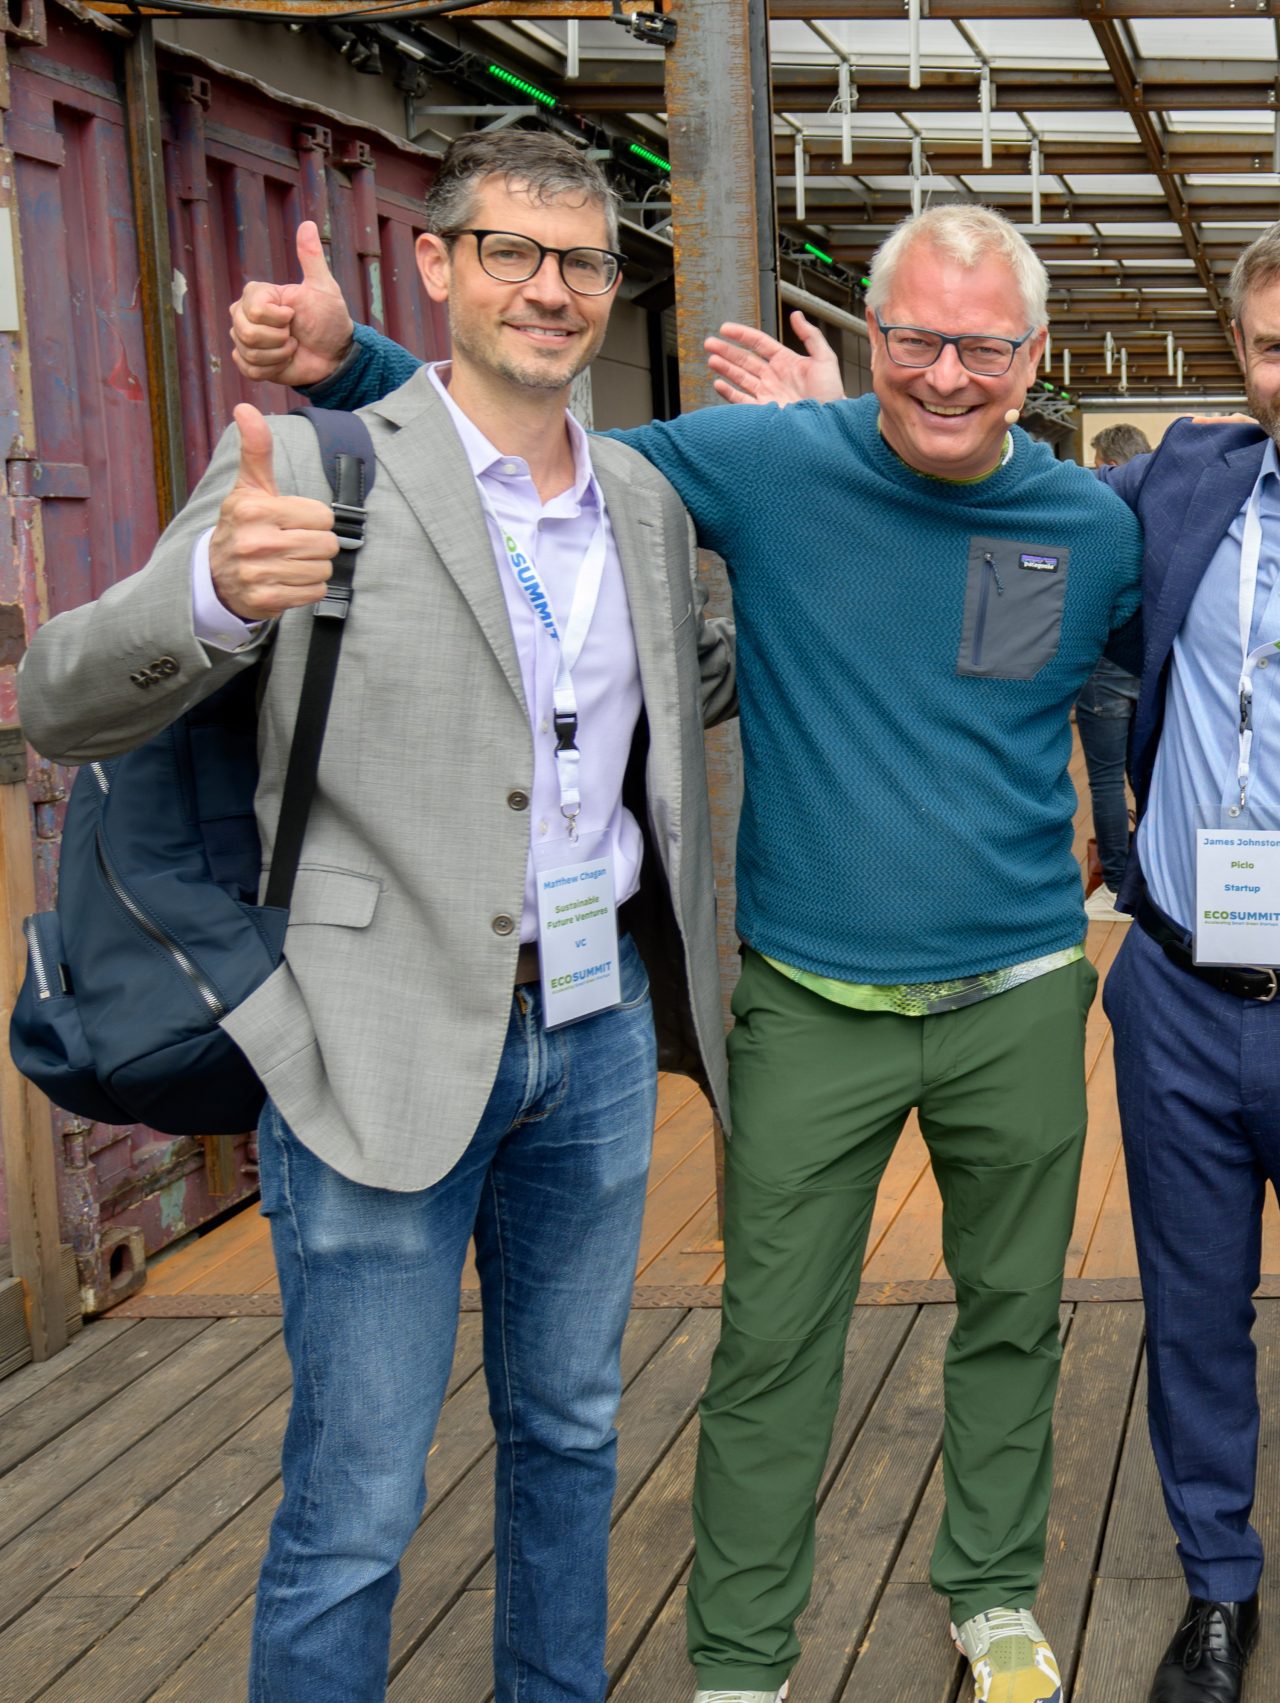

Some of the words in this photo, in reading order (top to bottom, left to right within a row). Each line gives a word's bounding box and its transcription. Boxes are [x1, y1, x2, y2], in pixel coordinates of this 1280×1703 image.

[1203, 838, 1235, 846] James
[1230, 861, 1255, 869] Piclo
[543, 875, 578, 890] Matthew
[1224, 884, 1261, 894] Startup
[554, 896, 600, 914] Sustainable
[547, 917, 574, 929] Future
[575, 907, 609, 922] Ventures
[1204, 911, 1280, 921] ECOSUMMIT
[575, 938, 587, 948] VC
[550, 961, 612, 989] ECOSUMMIT
